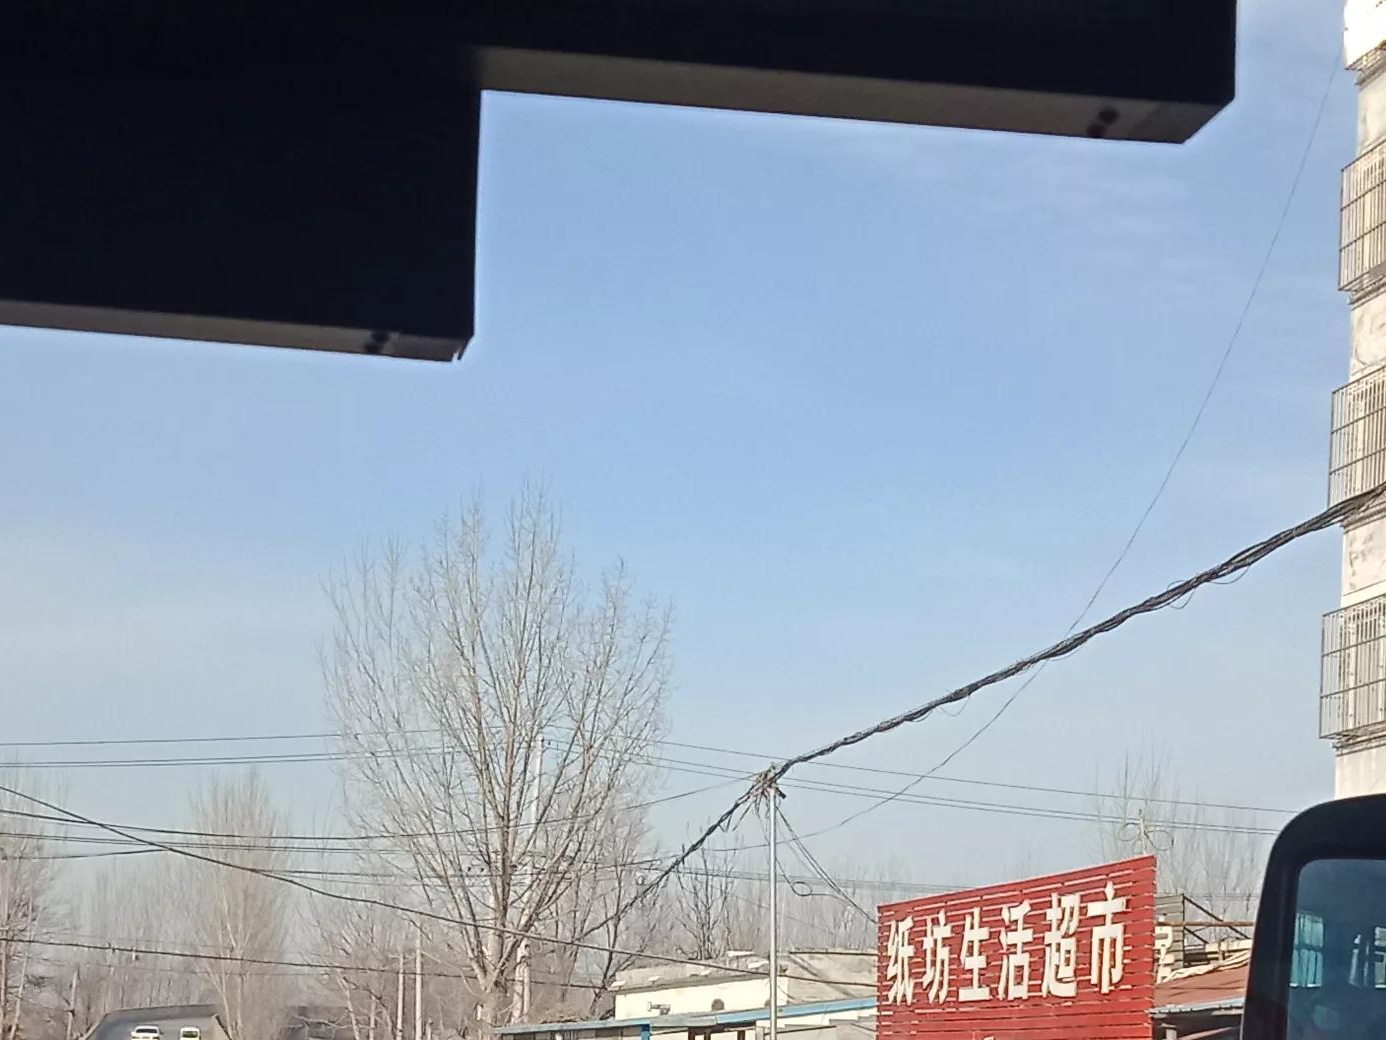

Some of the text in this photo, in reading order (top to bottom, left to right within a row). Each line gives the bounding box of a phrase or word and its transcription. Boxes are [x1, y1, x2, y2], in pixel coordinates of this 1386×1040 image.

[886, 881, 1127, 1006] 纸坊生活超市
